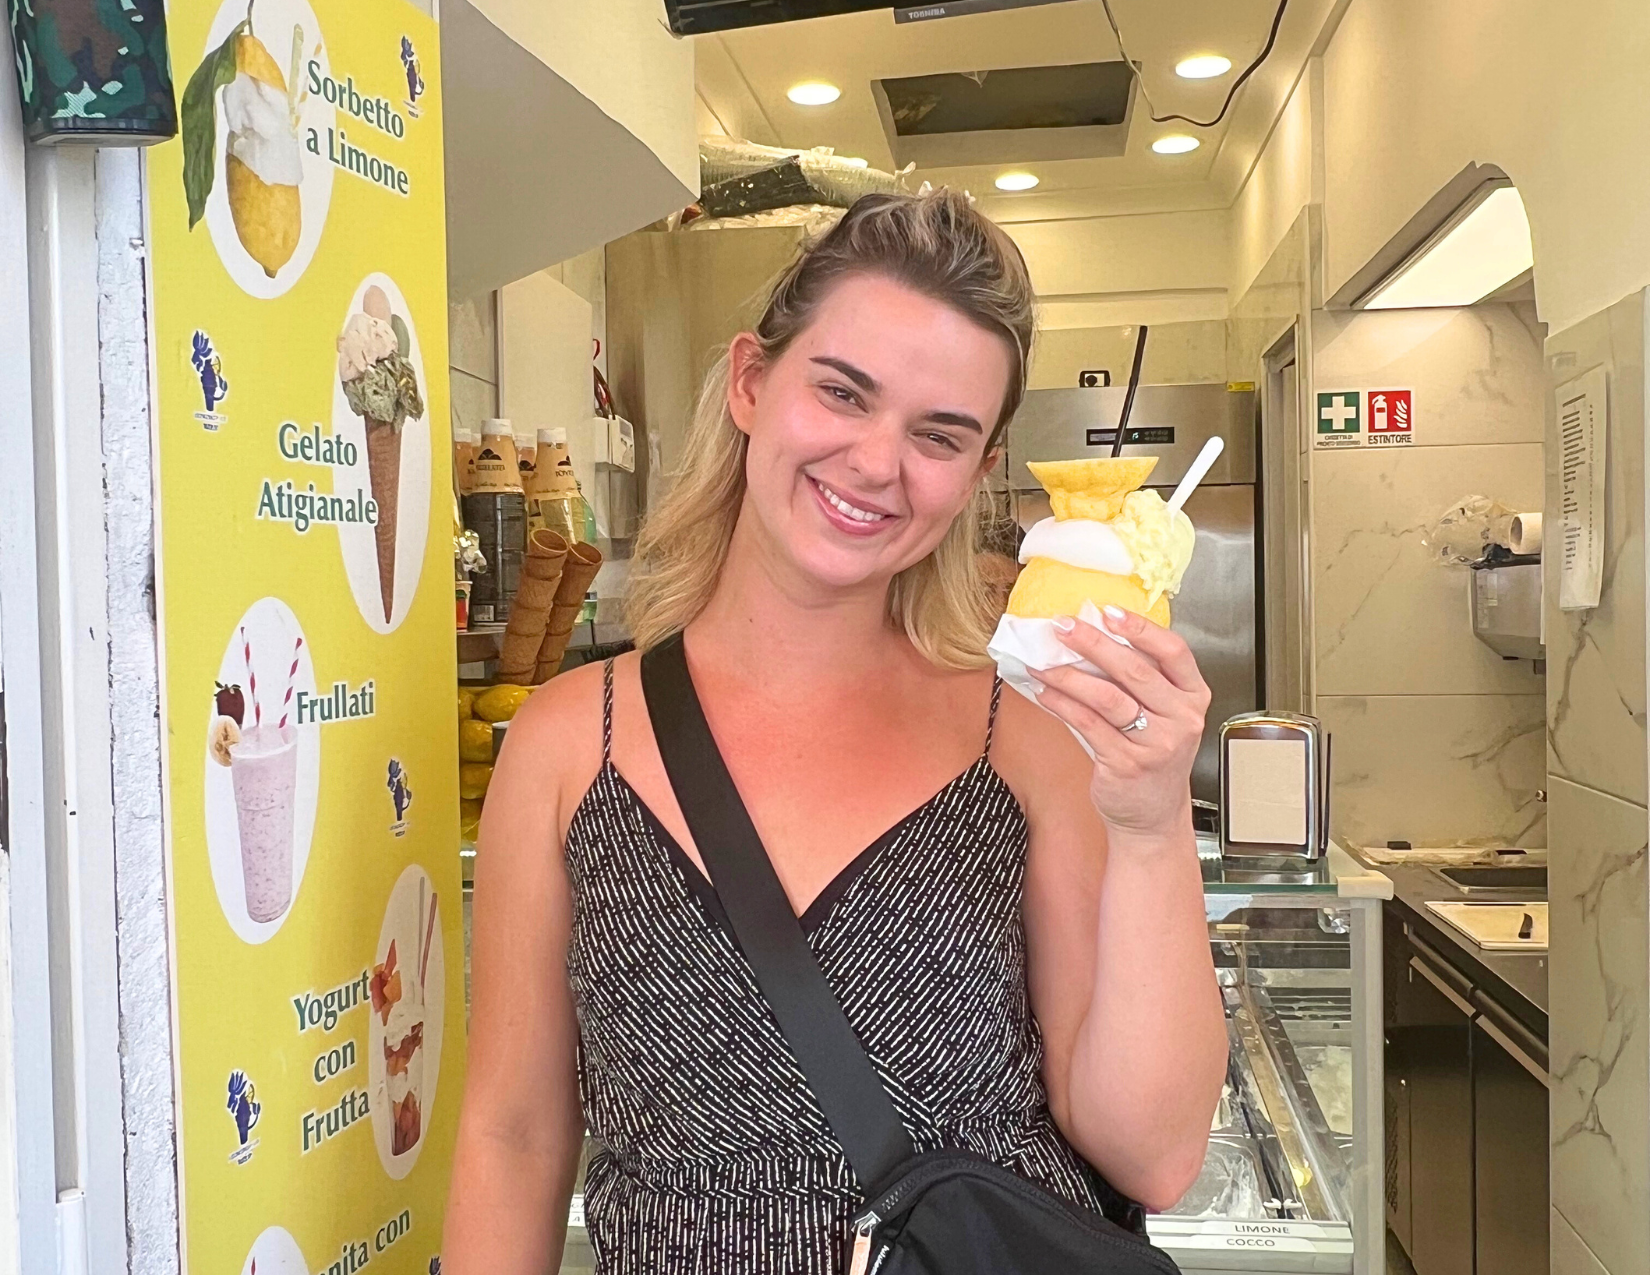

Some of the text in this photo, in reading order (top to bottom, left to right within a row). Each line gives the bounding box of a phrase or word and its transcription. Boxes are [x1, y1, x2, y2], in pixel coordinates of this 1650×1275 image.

[308, 60, 404, 138] Sorbetto
[306, 127, 408, 195] a Limone
[279, 423, 358, 467] Gelato
[1367, 434, 1412, 445] ESTINTORE
[258, 481, 377, 532] Atigianale
[296, 682, 375, 724] Frullati
[293, 969, 370, 1031] Yogurt
[314, 1041, 356, 1083] con
[303, 1090, 370, 1151] Frutta
[375, 1209, 411, 1252] con
[1226, 1238, 1275, 1247] COCCO
[1234, 1225, 1290, 1234] LIMONE
